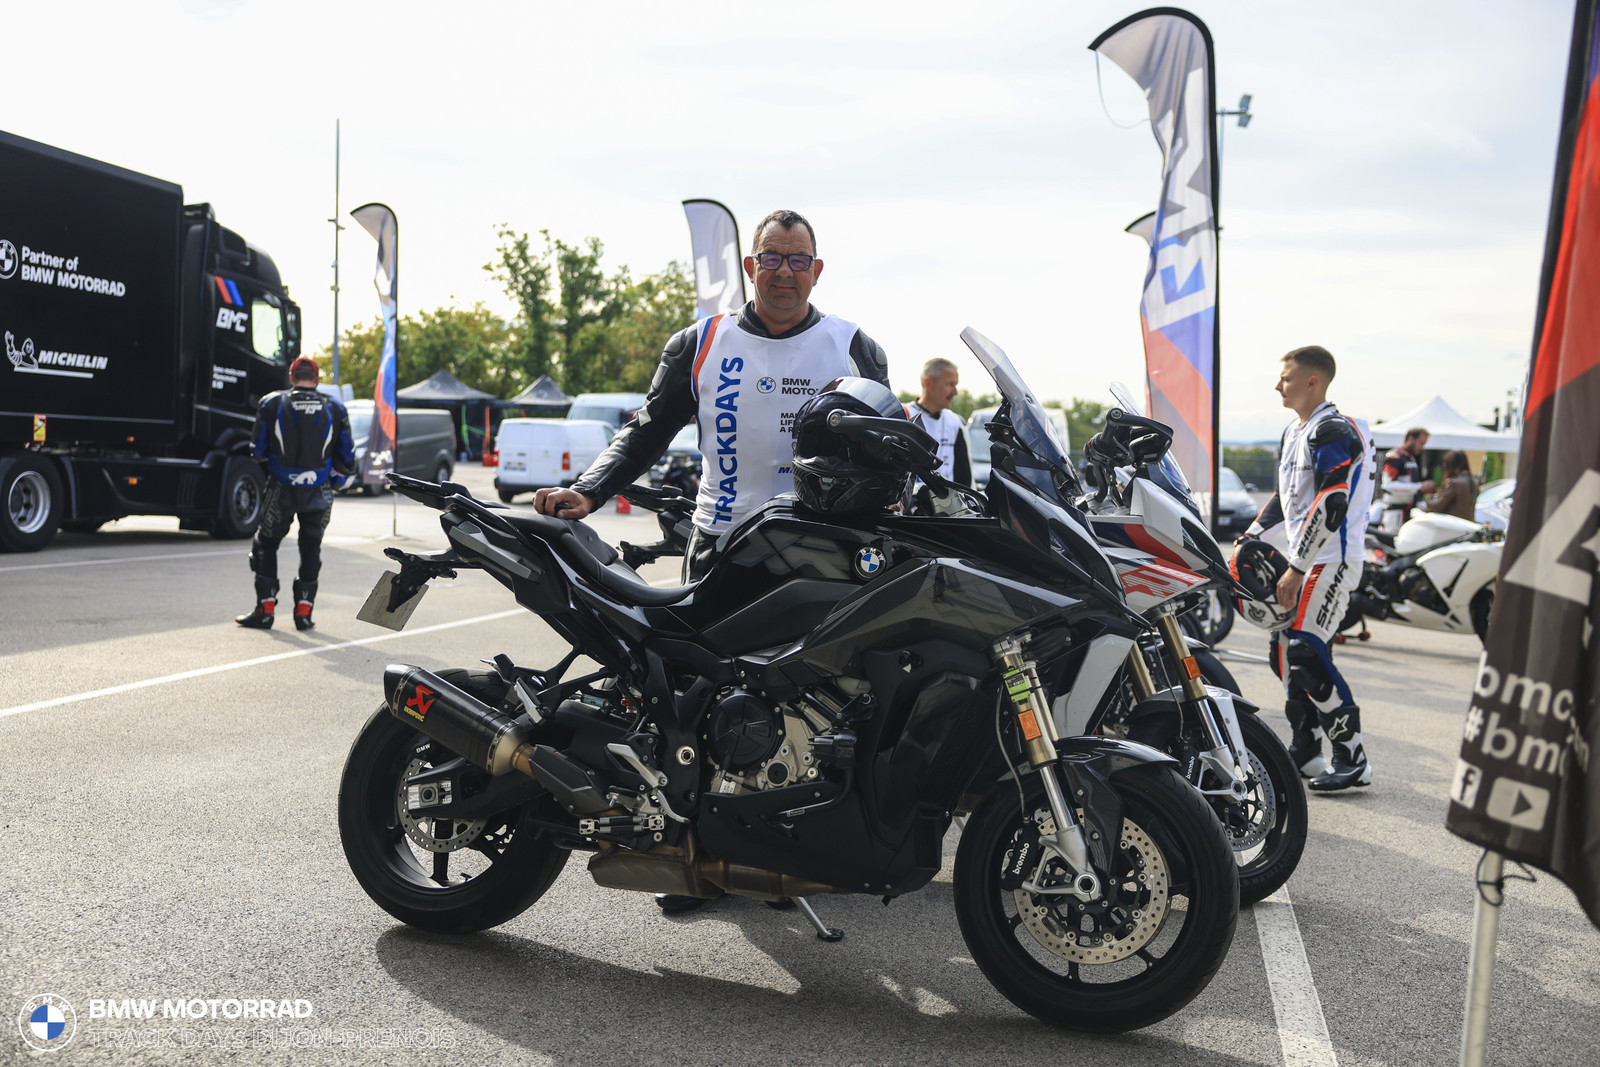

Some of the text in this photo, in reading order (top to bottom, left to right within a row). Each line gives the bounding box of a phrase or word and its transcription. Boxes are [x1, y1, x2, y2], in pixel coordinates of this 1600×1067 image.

[21, 246, 79, 271] Partner of
[21, 264, 126, 298] BMW MOTORRAD
[38, 350, 109, 370] MICHELIN
[781, 387, 819, 396] MOTO
[782, 377, 811, 387] BMW
[712, 357, 744, 526] TRACKDAYS
[1297, 507, 1323, 559] SHIMA
[1316, 561, 1349, 629] SHIMA
[1474, 650, 1576, 729] bmc
[1012, 842, 1030, 875] brembo
